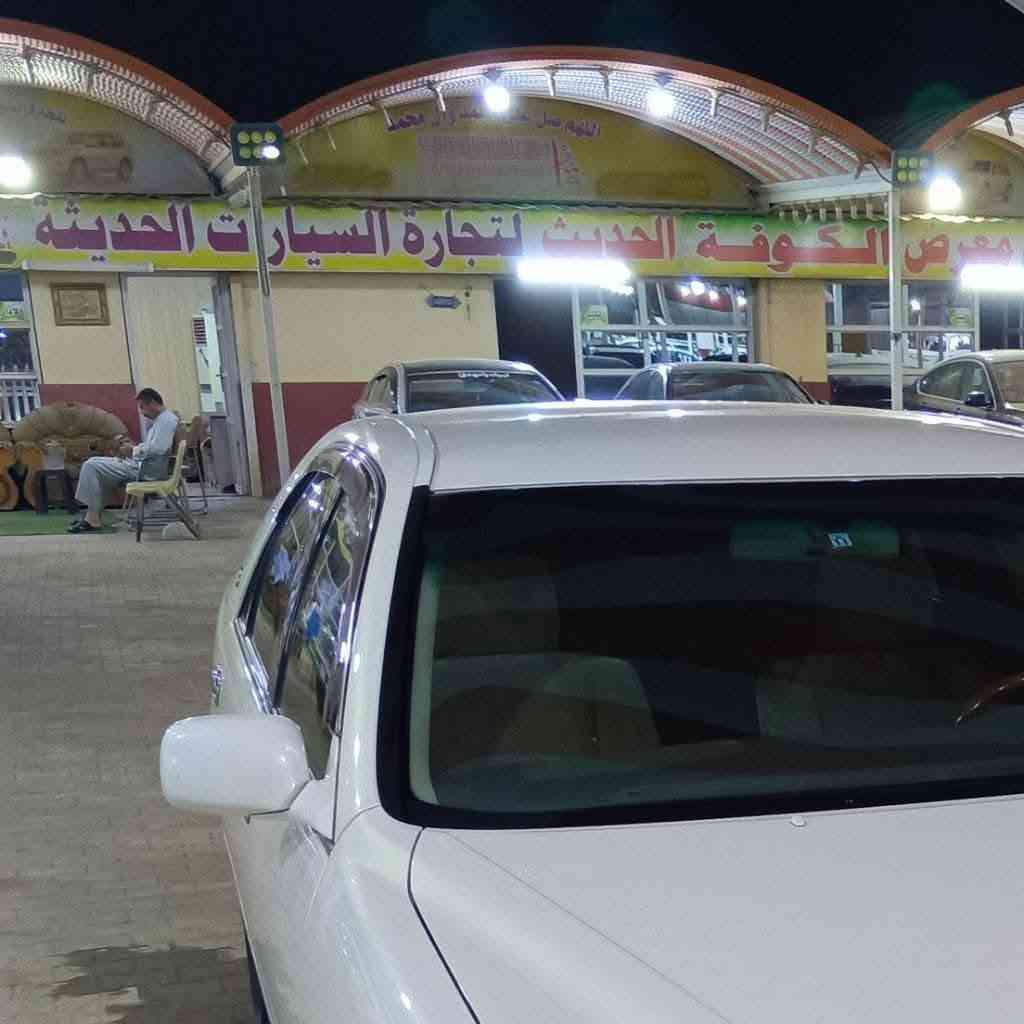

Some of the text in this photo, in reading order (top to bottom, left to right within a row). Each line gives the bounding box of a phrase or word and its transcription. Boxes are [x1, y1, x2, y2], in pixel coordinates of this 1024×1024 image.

[35, 198, 195, 262] الحديثة
[207, 205, 390, 266] السيارت
[403, 209, 522, 267] لتجارة
[696, 220, 889, 272] الكوفة
